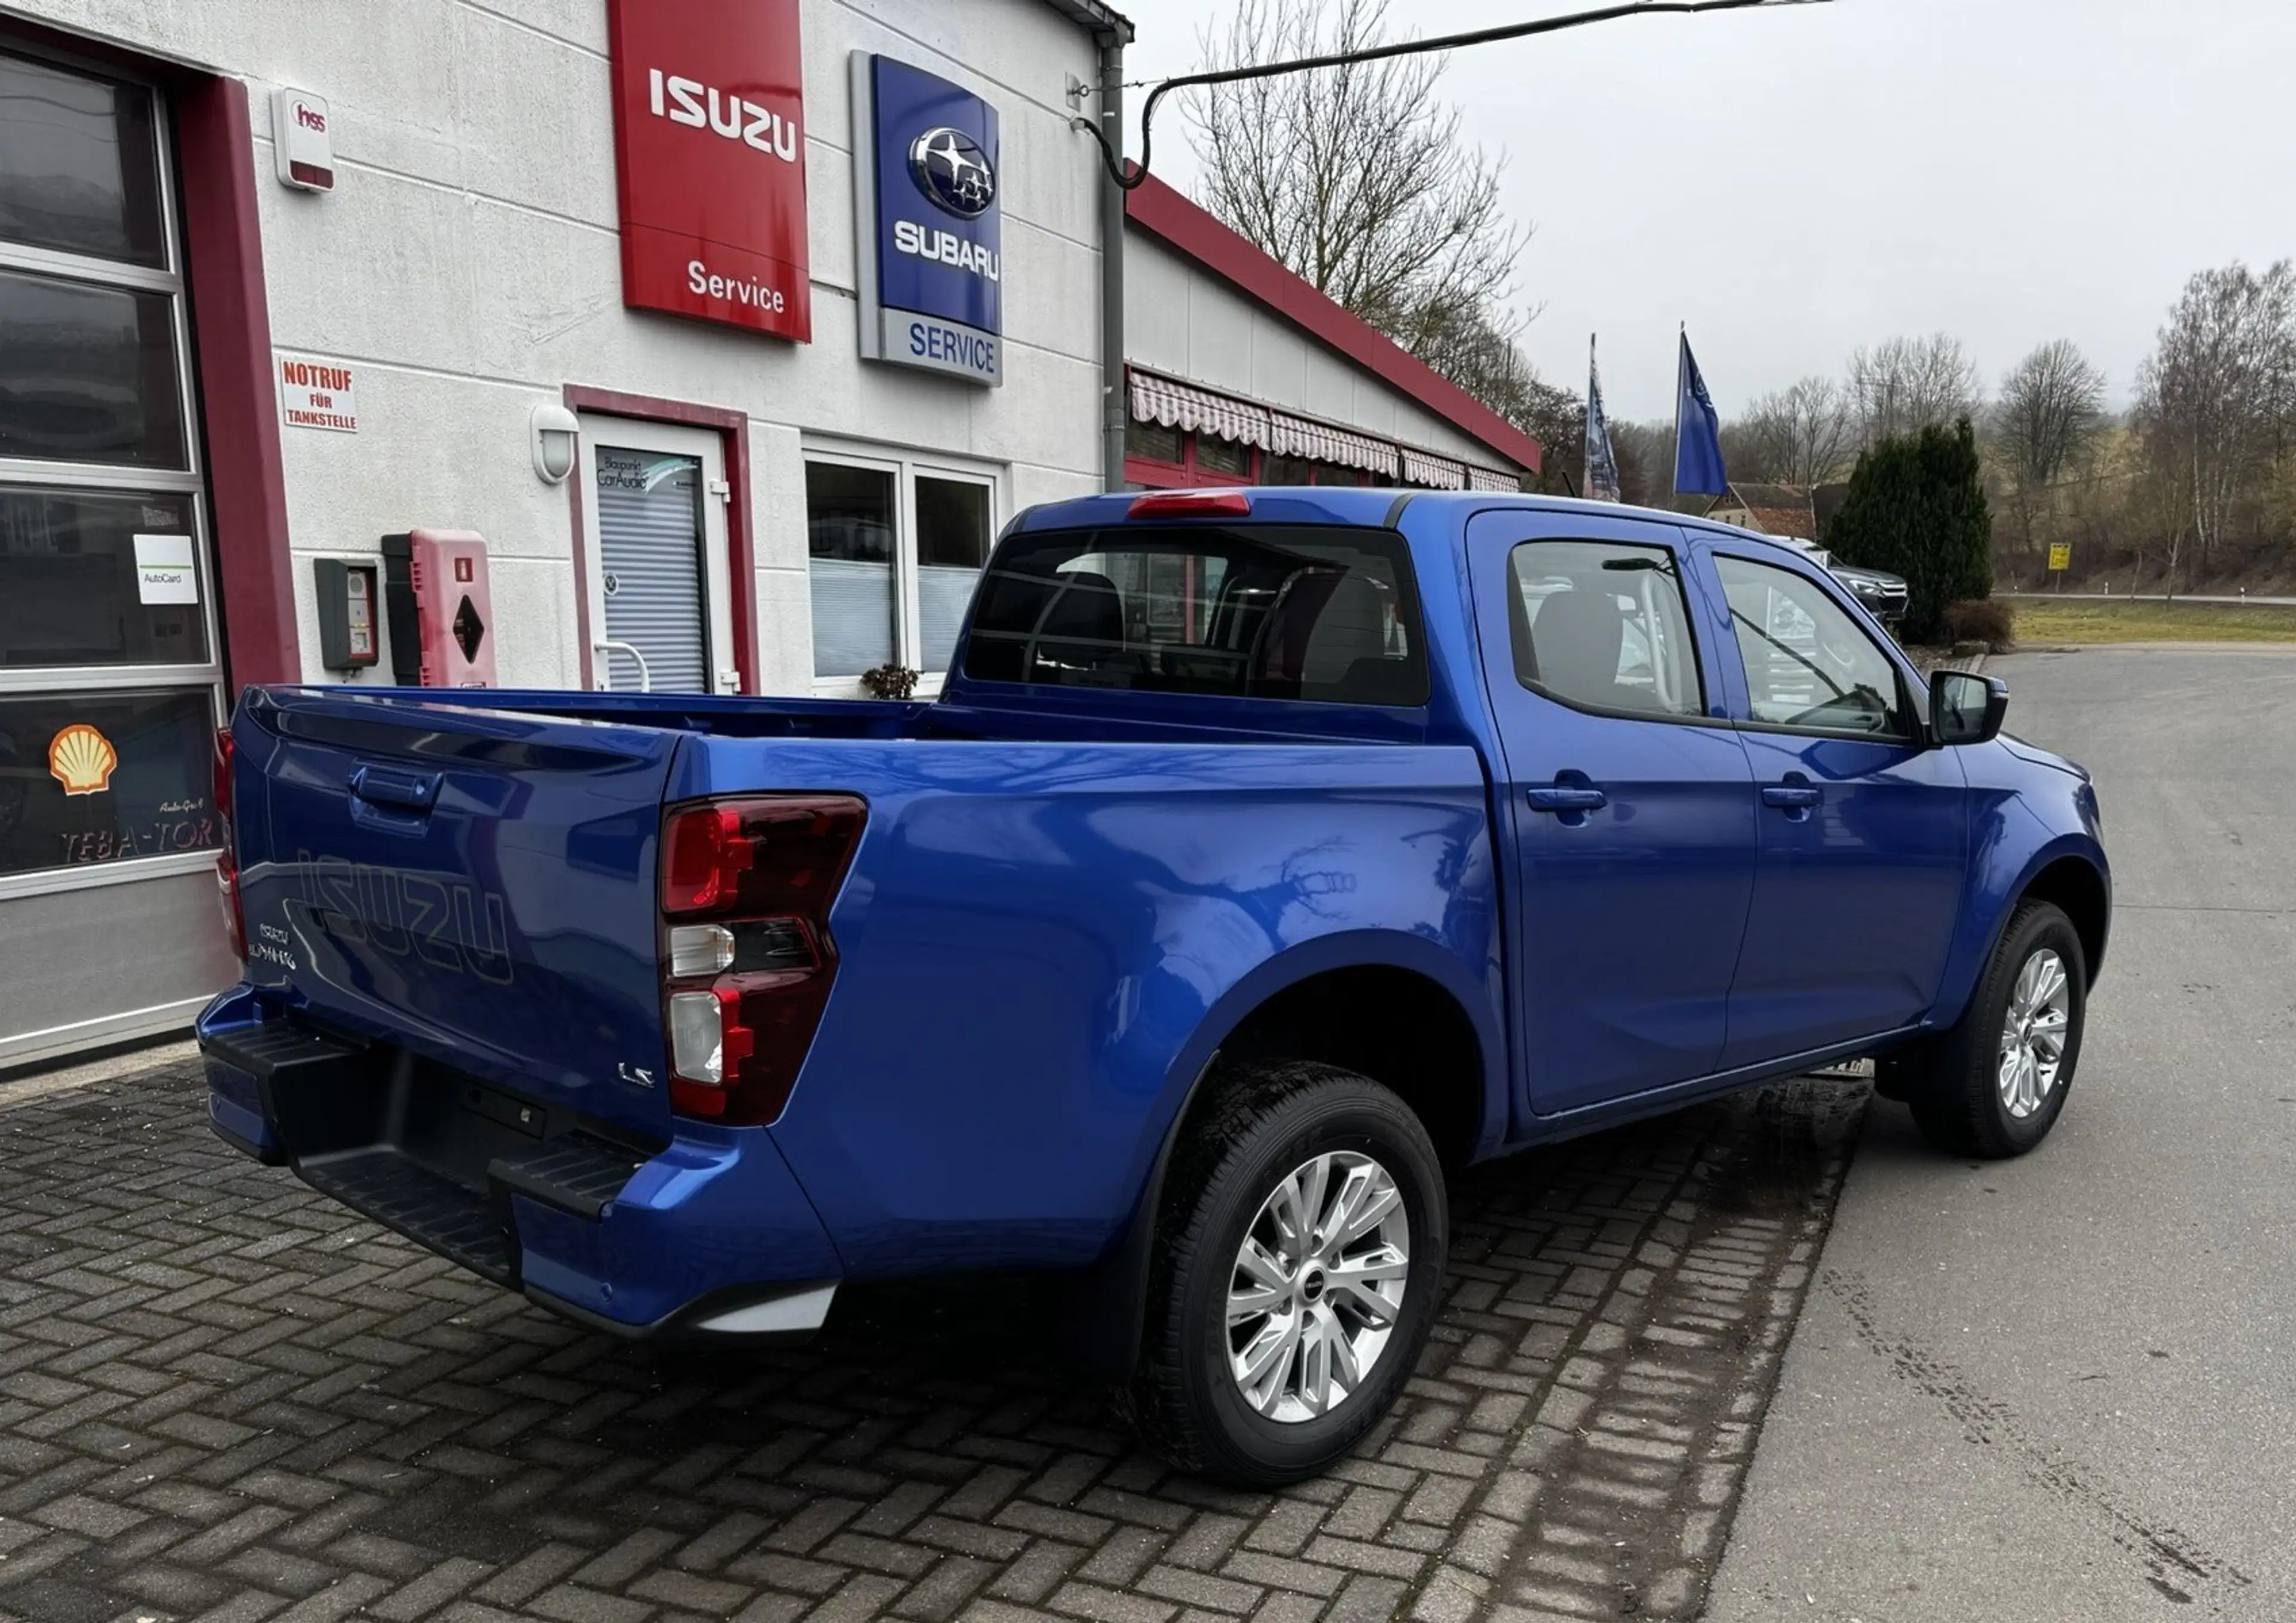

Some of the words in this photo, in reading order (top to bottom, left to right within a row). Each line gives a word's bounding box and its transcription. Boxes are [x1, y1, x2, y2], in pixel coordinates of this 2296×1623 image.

[649, 69, 796, 162] ISUZU
[894, 221, 999, 282] SUBARU
[688, 260, 784, 313] Service
[909, 323, 994, 373] SERVICE
[283, 361, 352, 391] NOTRUF
[309, 392, 332, 409] FÜR
[287, 409, 356, 429] TANKSTELLE
[300, 848, 514, 985] ISUZU
